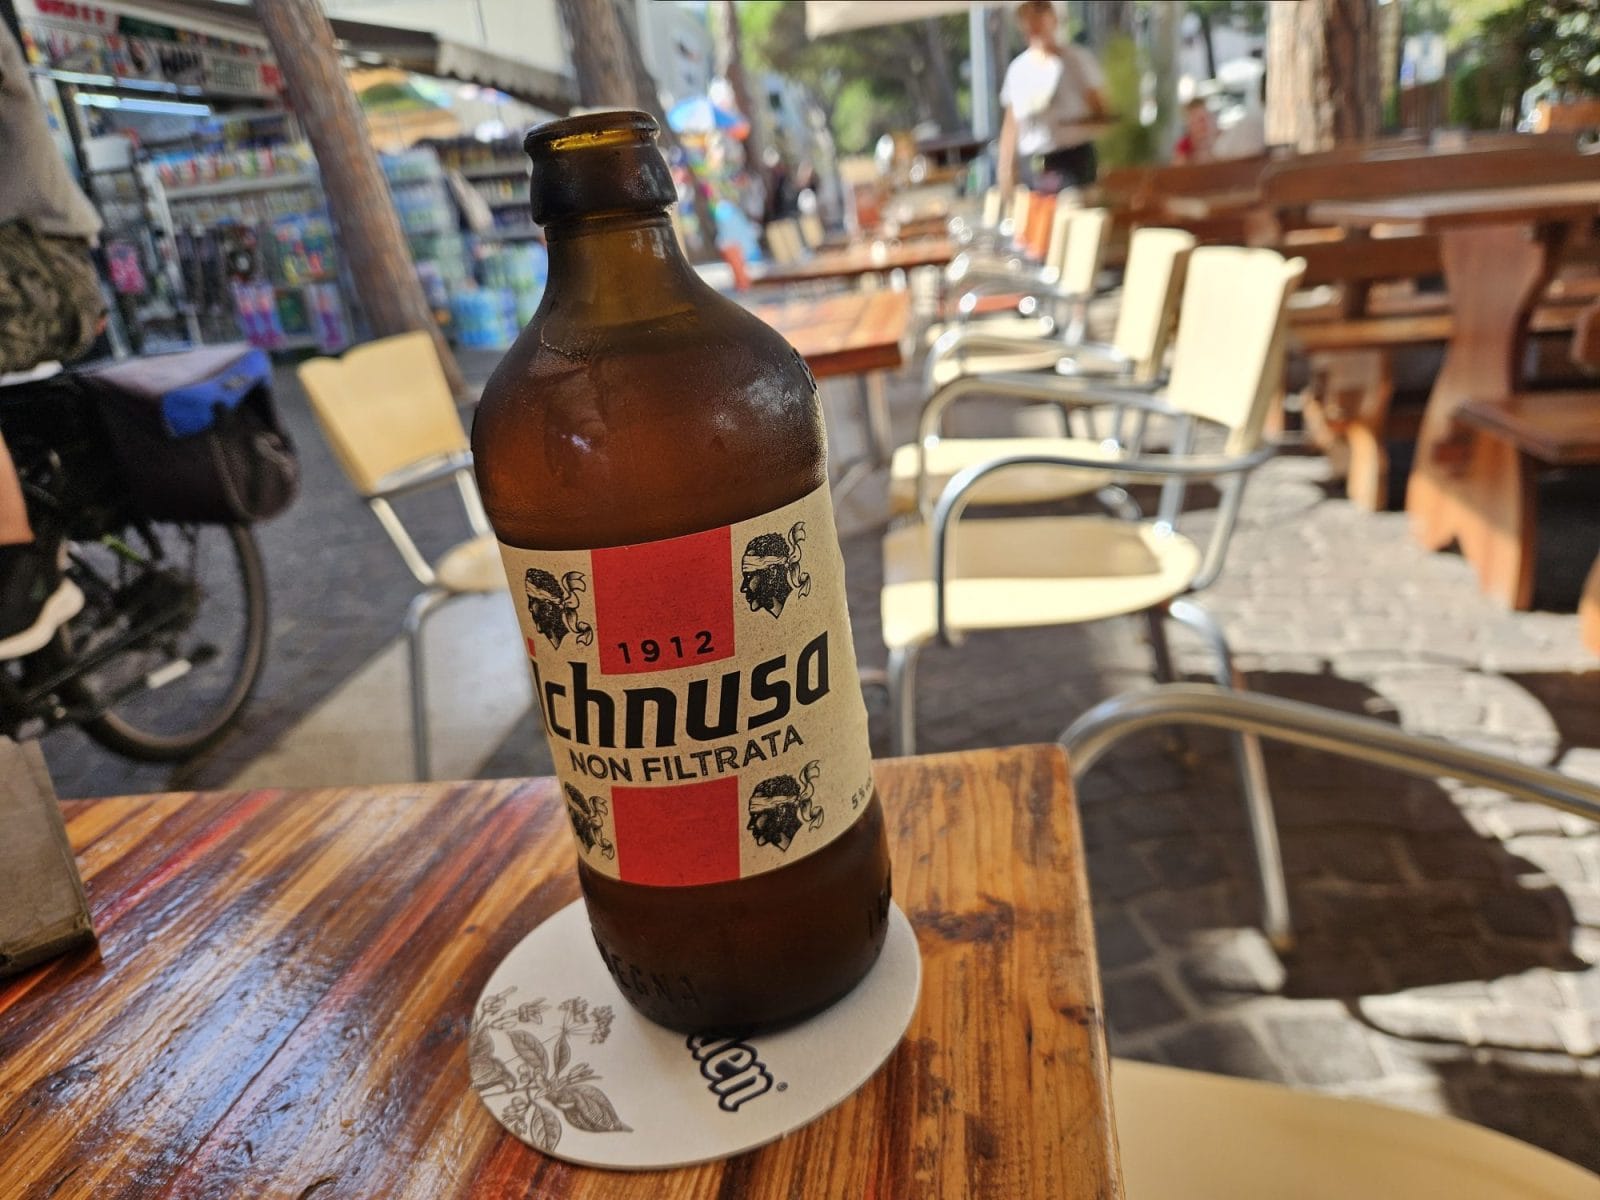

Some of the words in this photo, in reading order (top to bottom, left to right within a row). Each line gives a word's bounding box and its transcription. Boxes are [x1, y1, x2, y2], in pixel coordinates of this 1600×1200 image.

[617, 630, 715, 665] 1912
[569, 748, 633, 782] NON
[641, 724, 804, 782] FILTRATA
